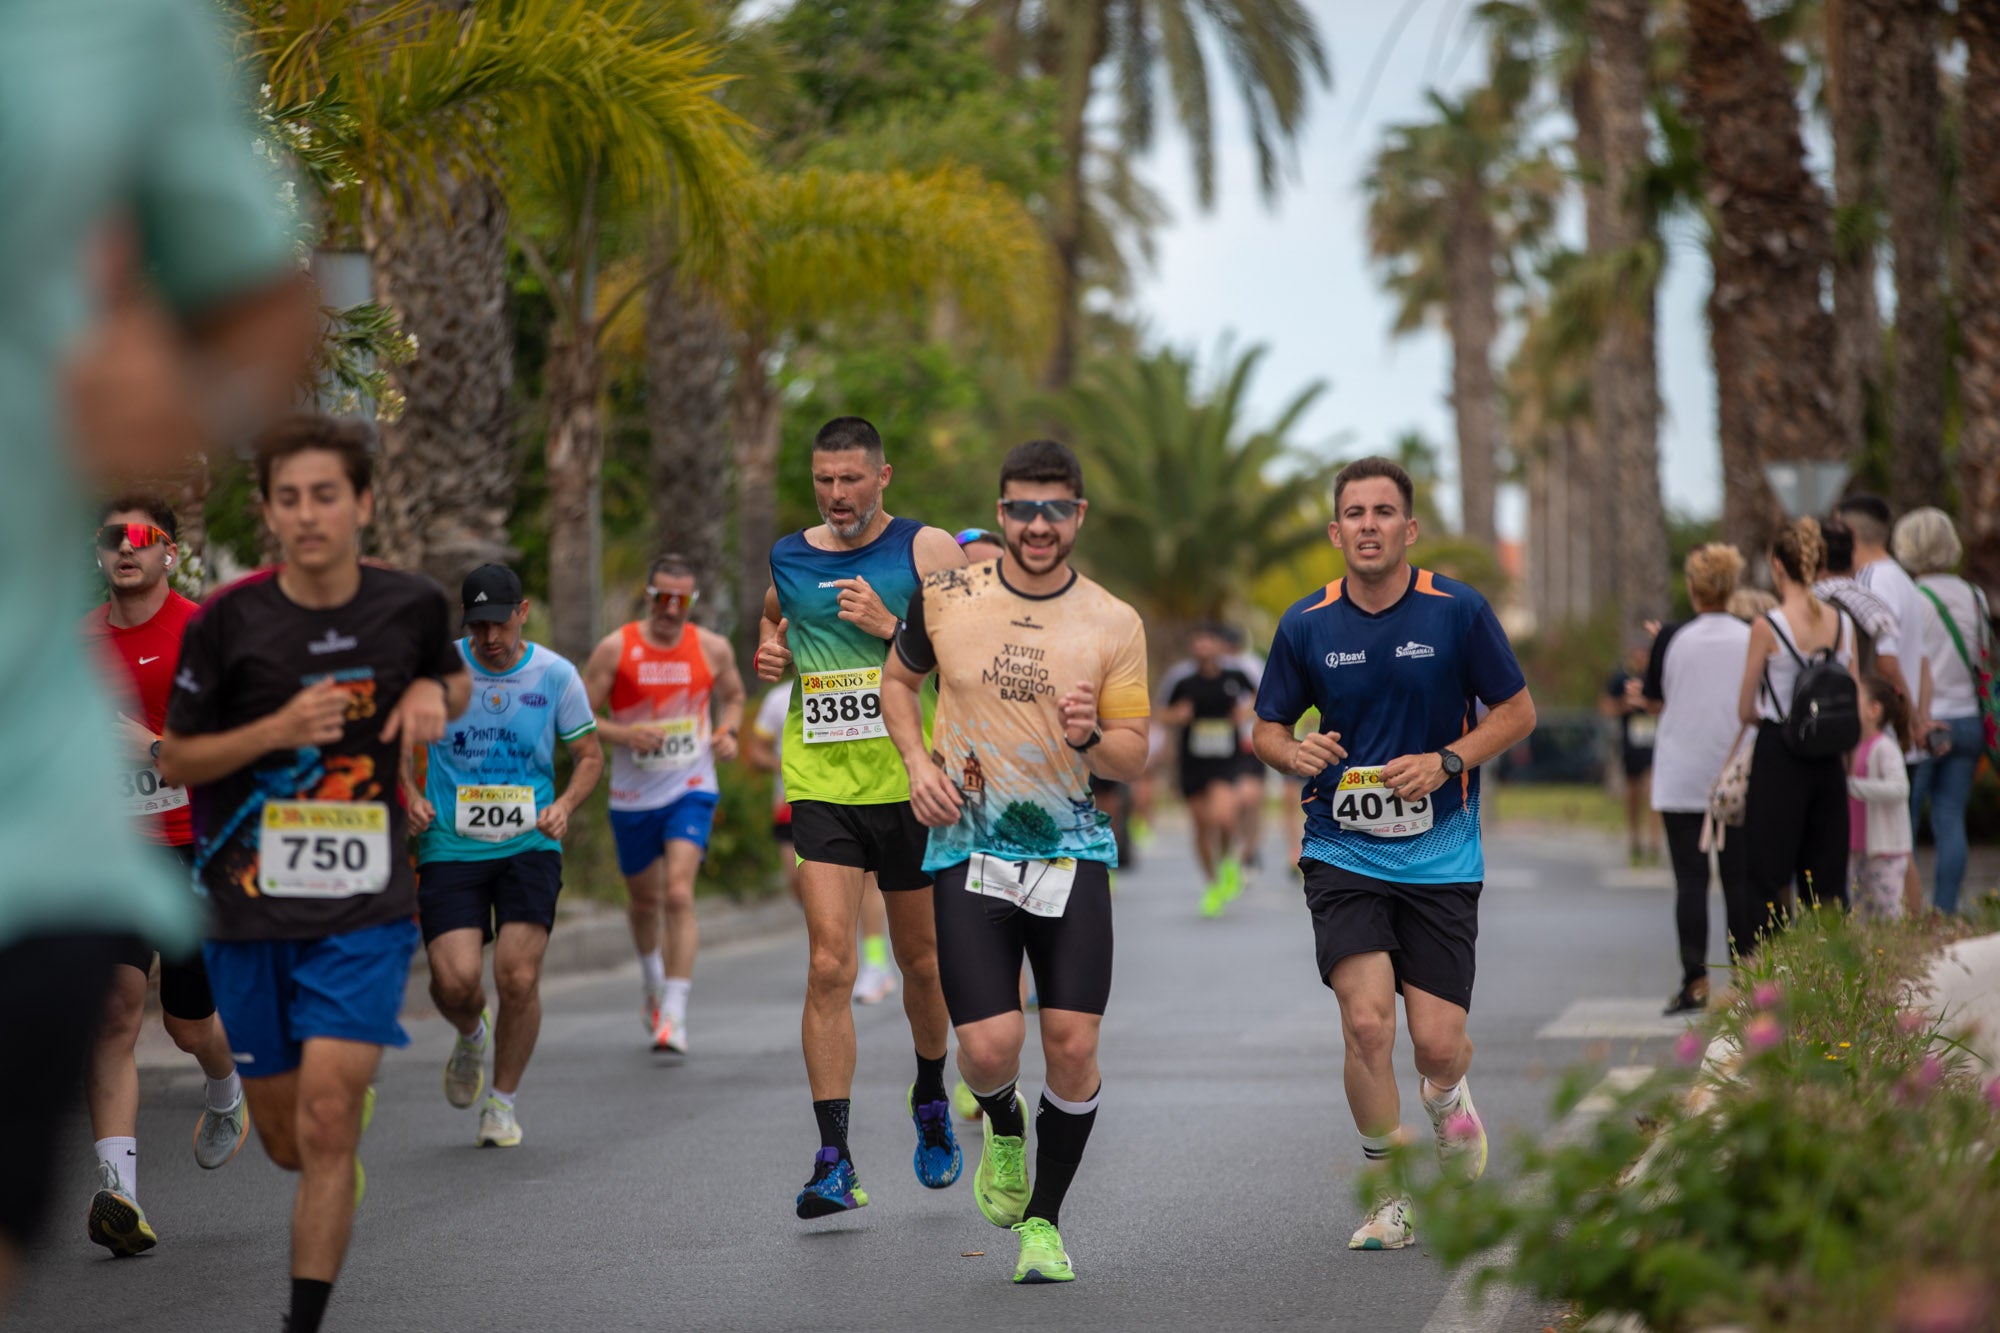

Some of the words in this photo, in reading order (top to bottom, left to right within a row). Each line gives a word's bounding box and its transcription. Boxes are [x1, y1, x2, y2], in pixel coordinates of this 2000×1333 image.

[1001, 643, 1045, 661] XLVIII
[1339, 650, 1366, 662] Roavi
[993, 656, 1049, 681] Media
[810, 677, 821, 689] 38
[820, 677, 864, 689] FONDO
[982, 669, 1056, 696] Maratón
[1000, 688, 1037, 704] BAZA
[806, 692, 882, 724] 3389
[1346, 772, 1360, 784] 38
[469, 805, 525, 828] 204
[281, 836, 368, 872] 750
[1013, 861, 1029, 885] 1
